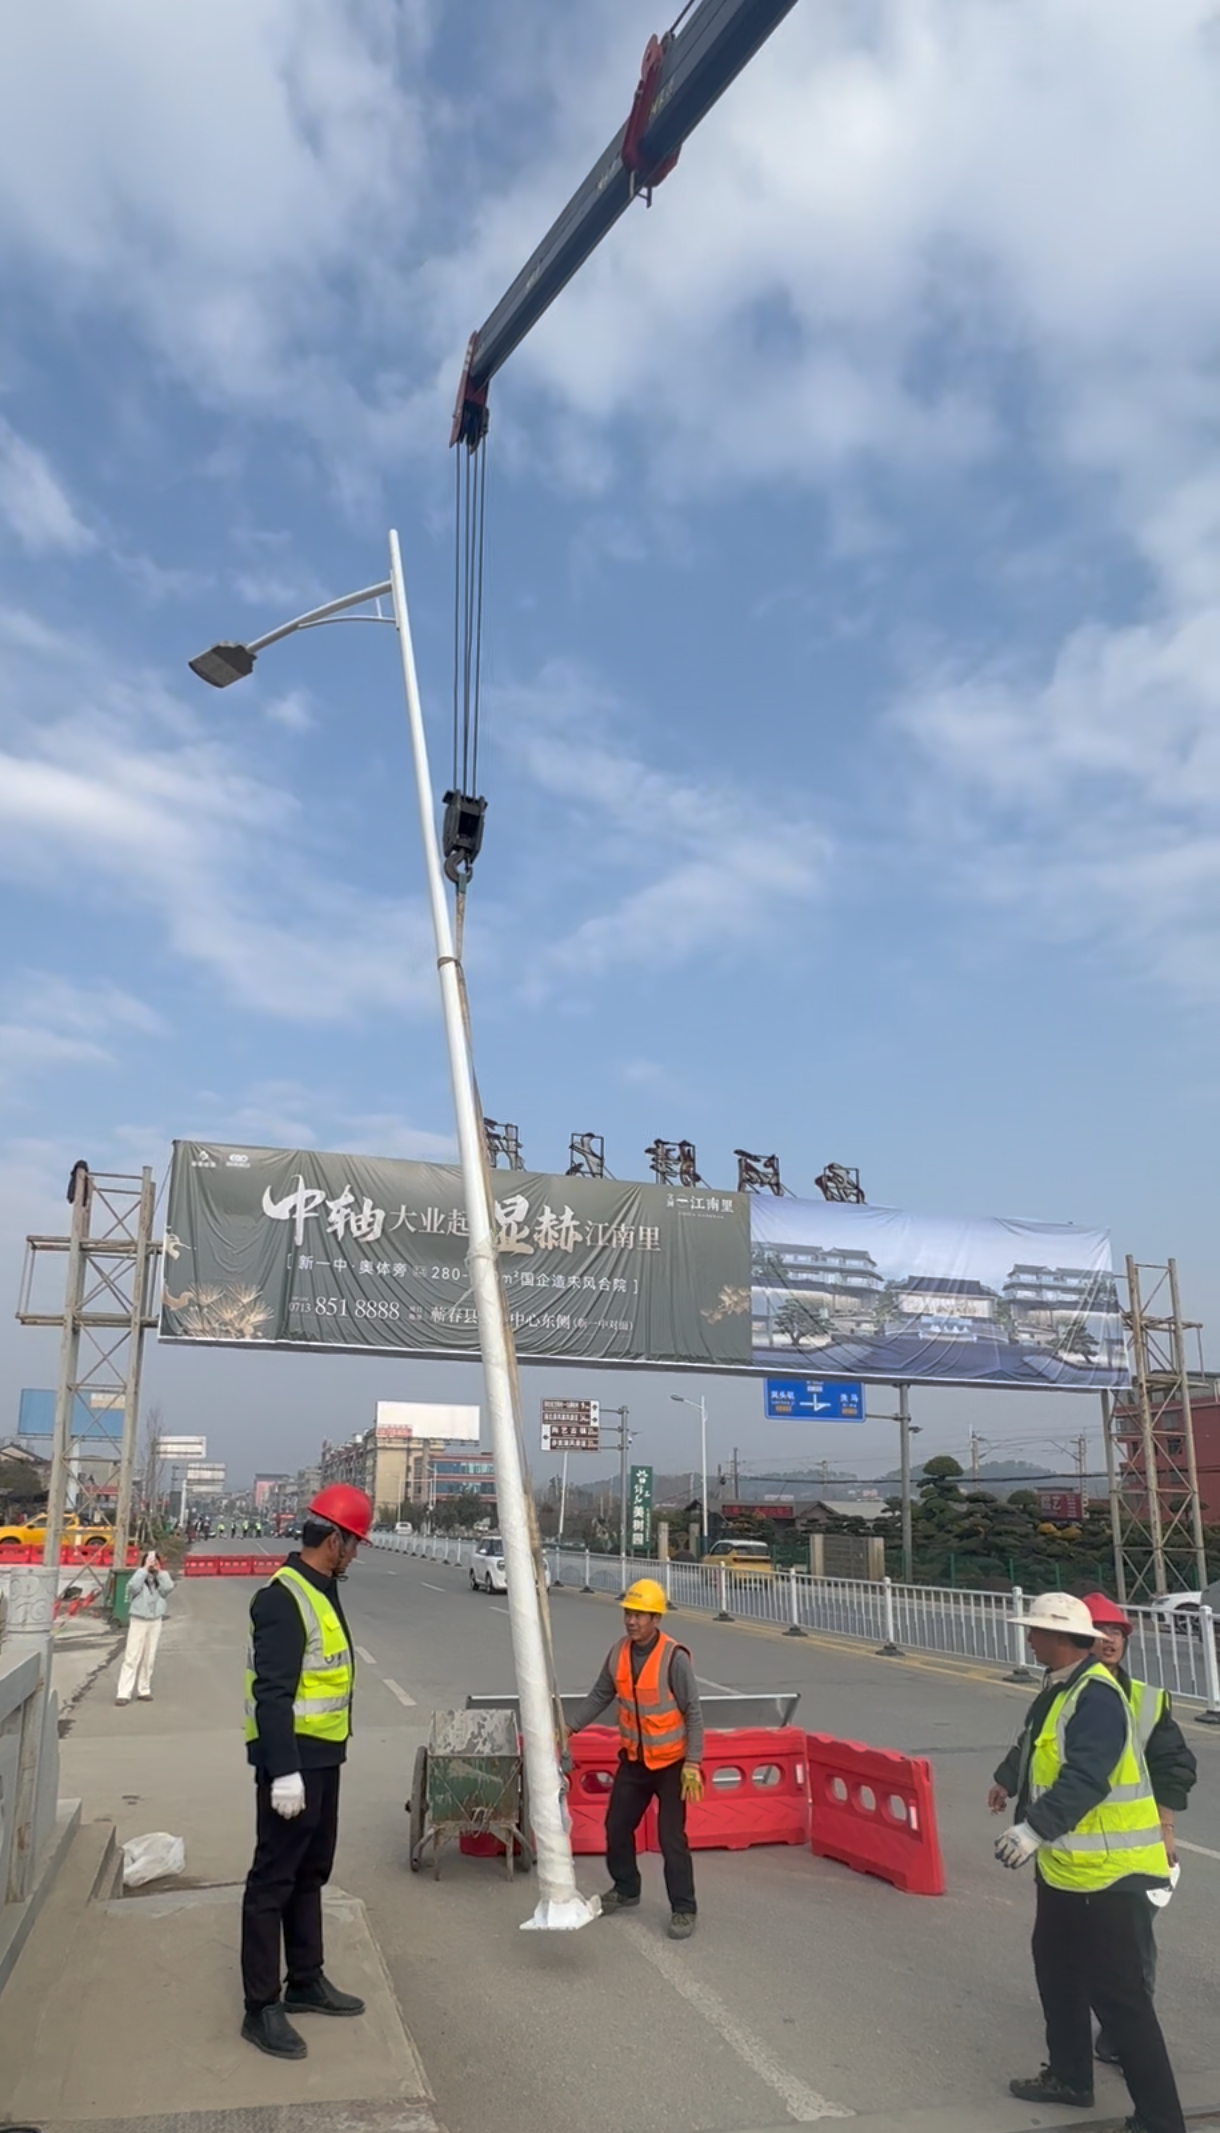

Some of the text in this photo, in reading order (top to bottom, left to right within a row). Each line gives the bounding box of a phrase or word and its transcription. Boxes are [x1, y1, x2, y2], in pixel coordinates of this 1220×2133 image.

[289, 1302, 311, 1314] 0713
[315, 1296, 349, 1317] 851
[355, 1299, 400, 1320] 8888
